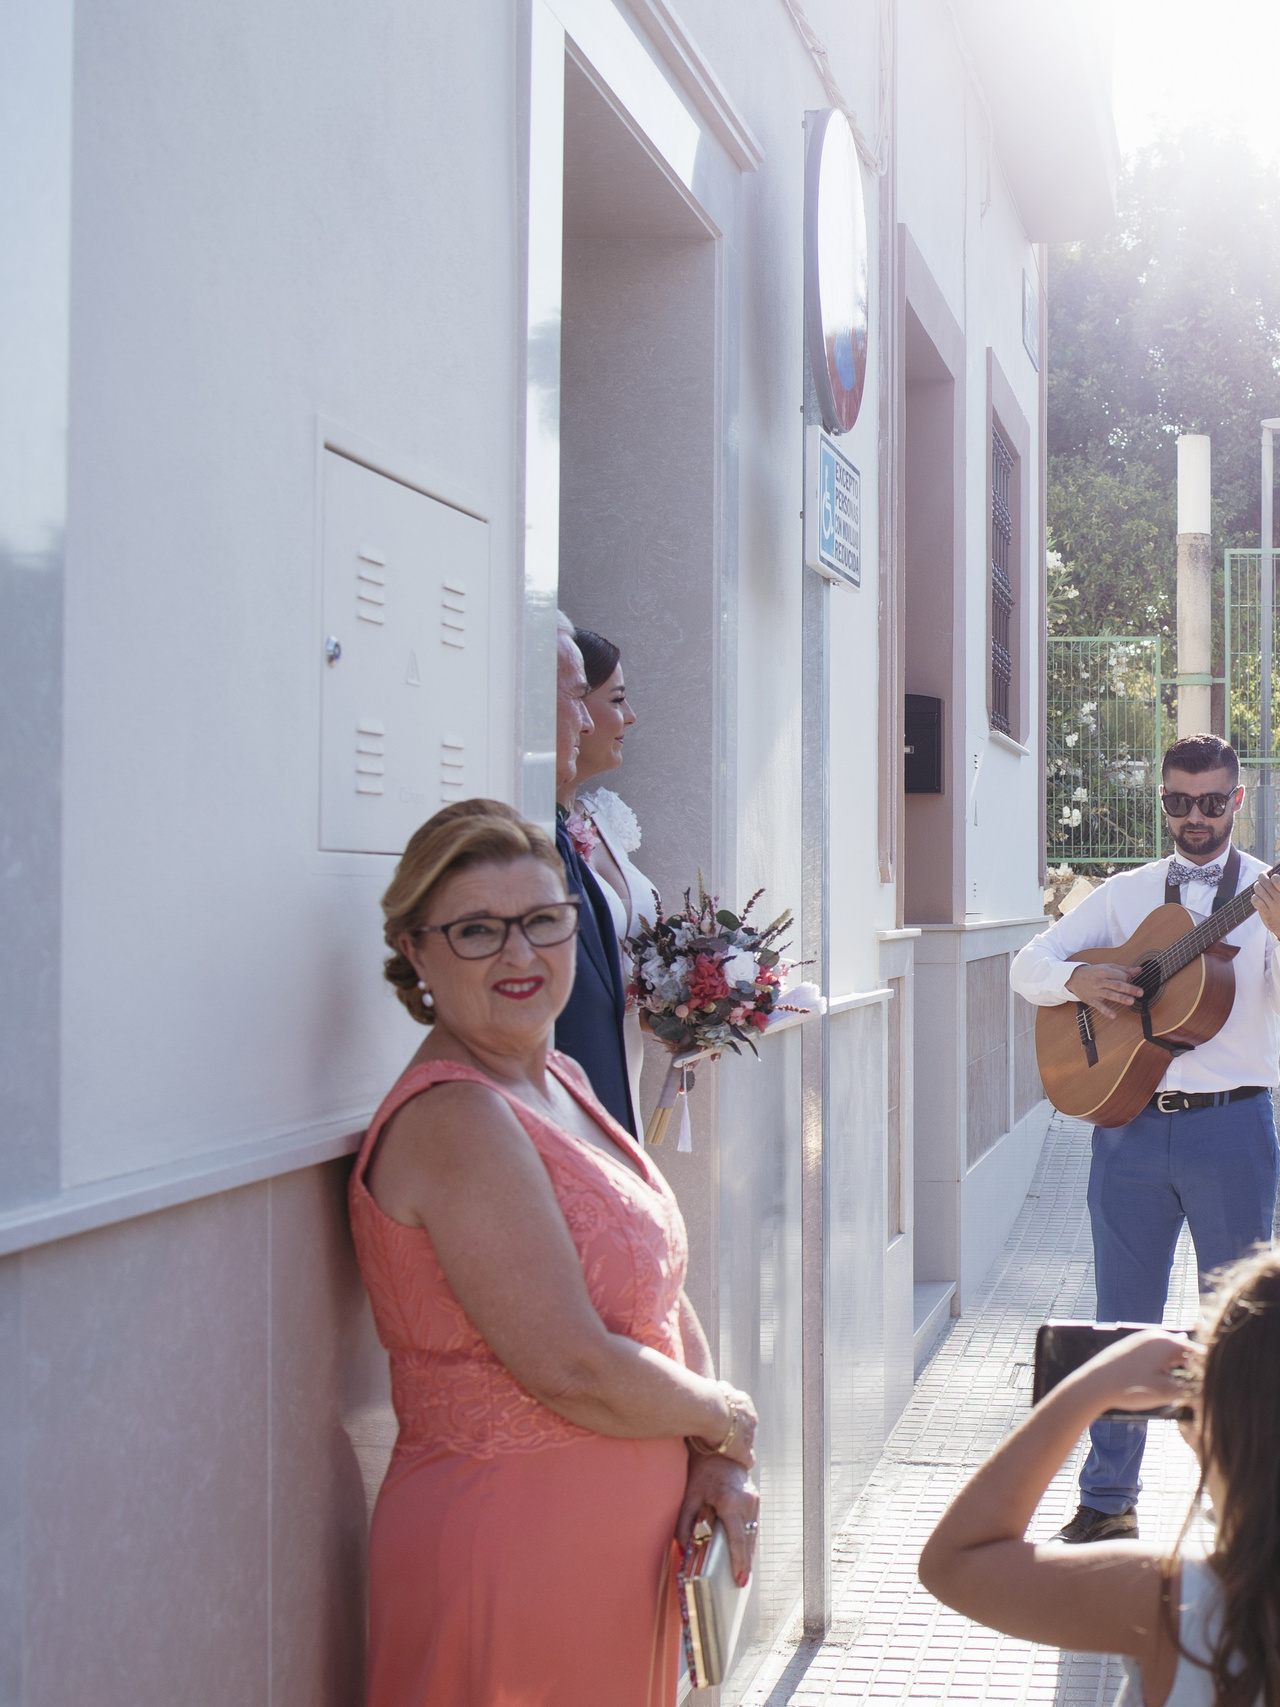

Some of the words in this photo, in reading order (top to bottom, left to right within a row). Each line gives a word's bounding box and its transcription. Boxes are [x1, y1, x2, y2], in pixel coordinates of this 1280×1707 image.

[835, 460, 858, 499] EXCEPTO
[835, 486, 858, 525] PERSONAS
[835, 539, 859, 573] REDUCIDA
